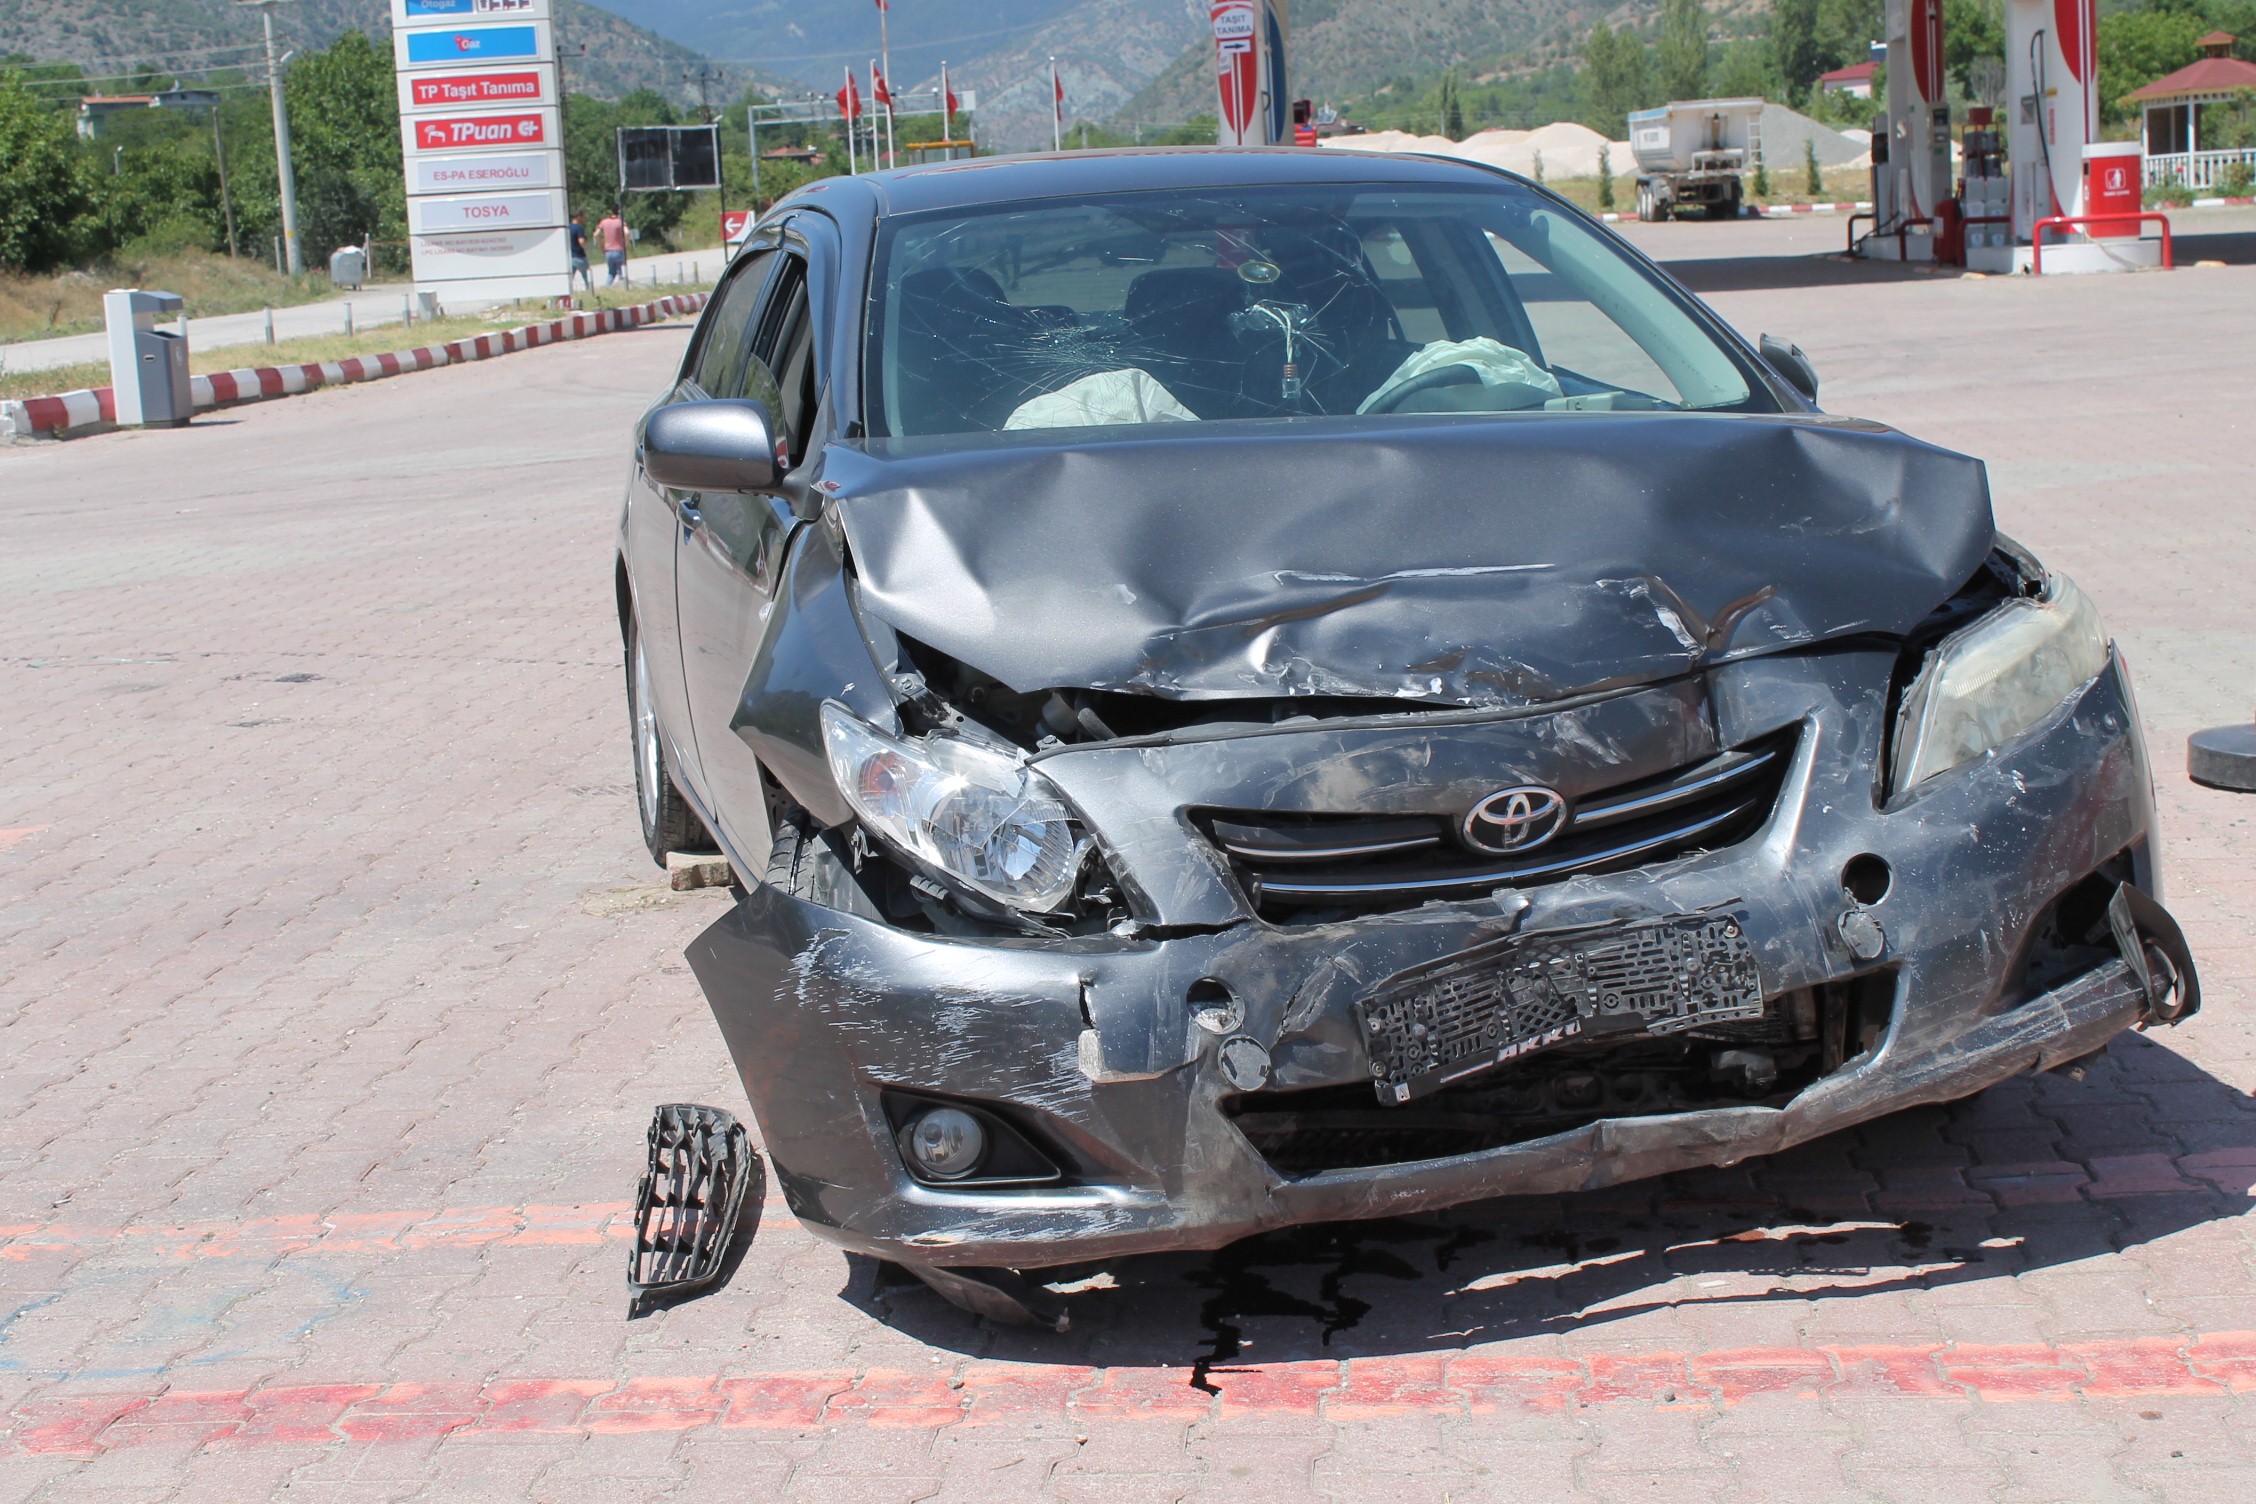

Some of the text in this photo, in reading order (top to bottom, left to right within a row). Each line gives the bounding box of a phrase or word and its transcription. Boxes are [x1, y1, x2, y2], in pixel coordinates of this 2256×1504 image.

[1216, 25, 1252, 35] TANIMA
[418, 81, 535, 99] TP Taşıt Tanıma
[450, 122, 512, 141] TPuan
[433, 167, 529, 181] ES-PA ESEROĞLU
[462, 205, 510, 218] TOSYA
